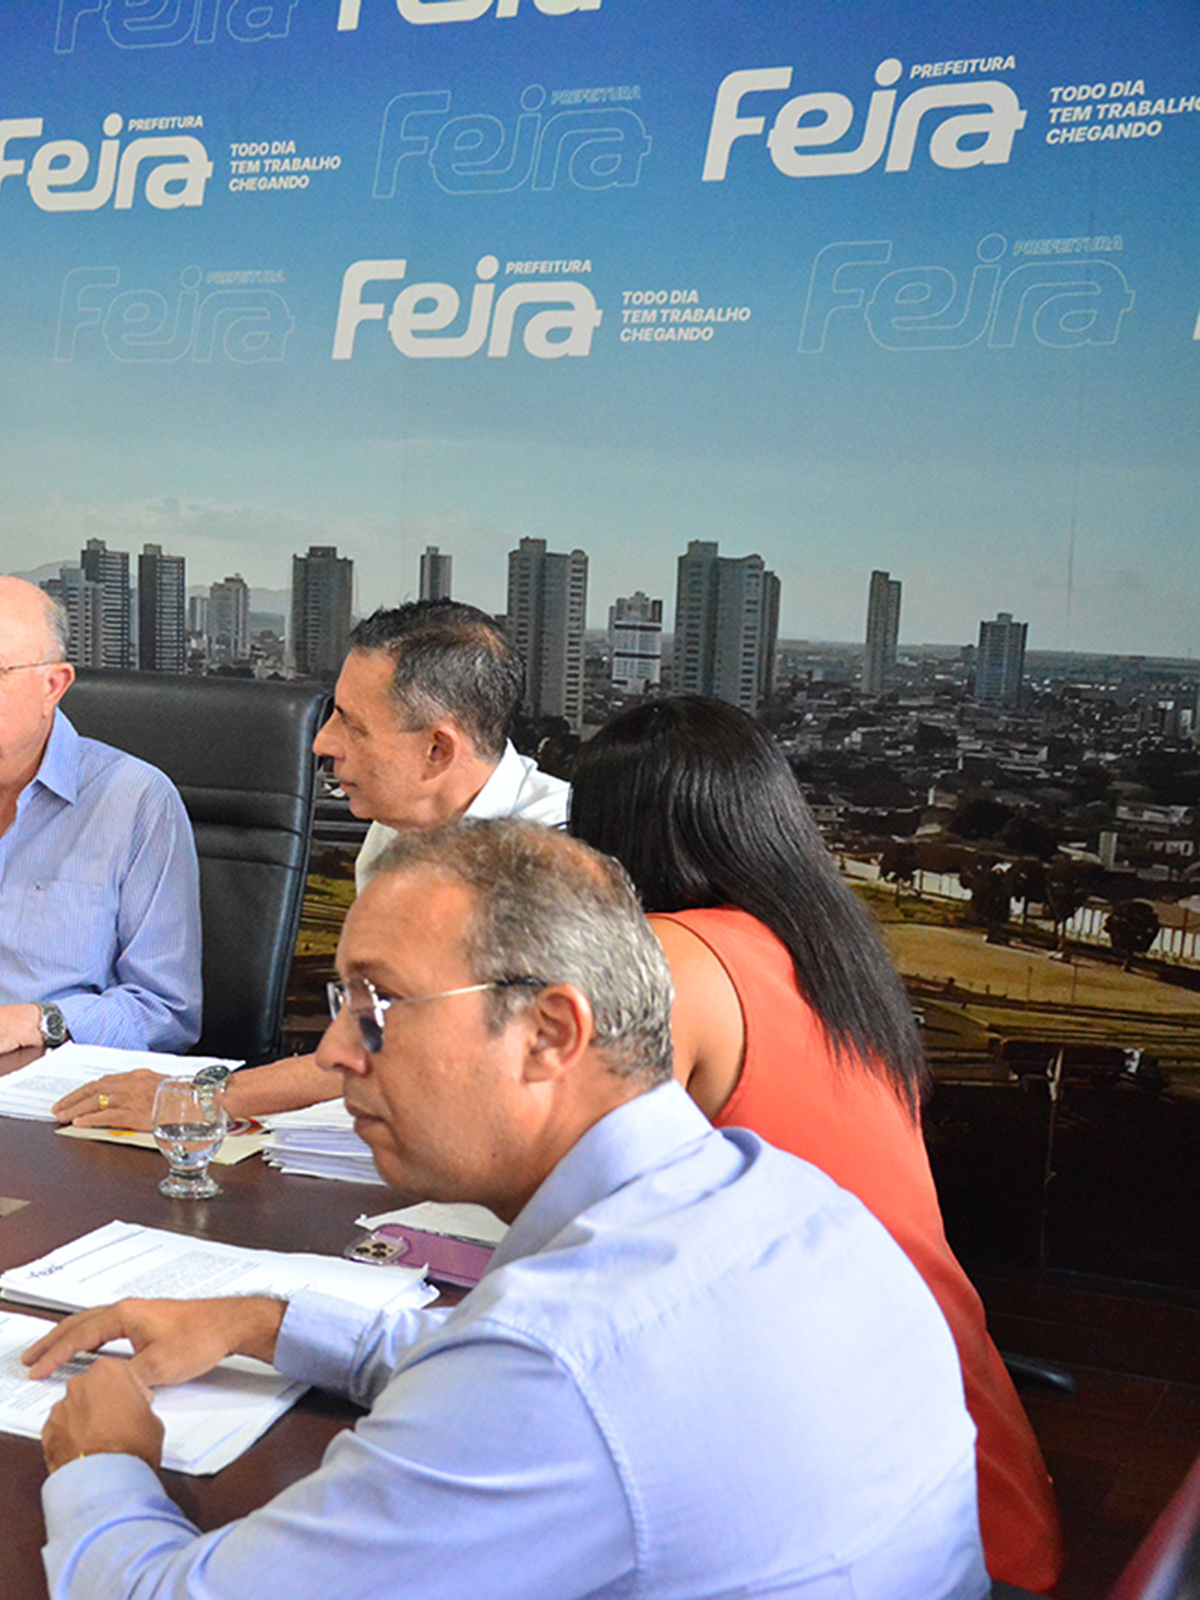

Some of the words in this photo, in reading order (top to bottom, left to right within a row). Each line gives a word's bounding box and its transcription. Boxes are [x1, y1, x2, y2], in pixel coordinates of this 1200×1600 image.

[909, 55, 1017, 79] PREFEITURA
[1050, 83, 1107, 103] TODO
[1108, 79, 1145, 98] DIA
[128, 115, 204, 131] PREFEITURA
[701, 57, 1027, 182] Feira
[1049, 105, 1093, 124] TEM
[372, 84, 653, 198] Feira
[1045, 120, 1163, 145] CHEGANDO
[229, 142, 269, 157] TODO
[270, 140, 297, 156] DIA
[229, 158, 260, 174] TEM
[262, 155, 342, 172] TRABALHO
[228, 174, 310, 192] CHEGANDO
[504, 259, 592, 275] PREFEITURA
[621, 290, 669, 306] TODO
[669, 289, 700, 305] DIA
[797, 233, 1135, 354] Feira
[54, 265, 295, 364] Feira
[331, 254, 603, 361] Feira
[621, 309, 657, 325] TEM
[658, 307, 752, 324] TRABALHO
[619, 326, 714, 343] CHEGANDO
